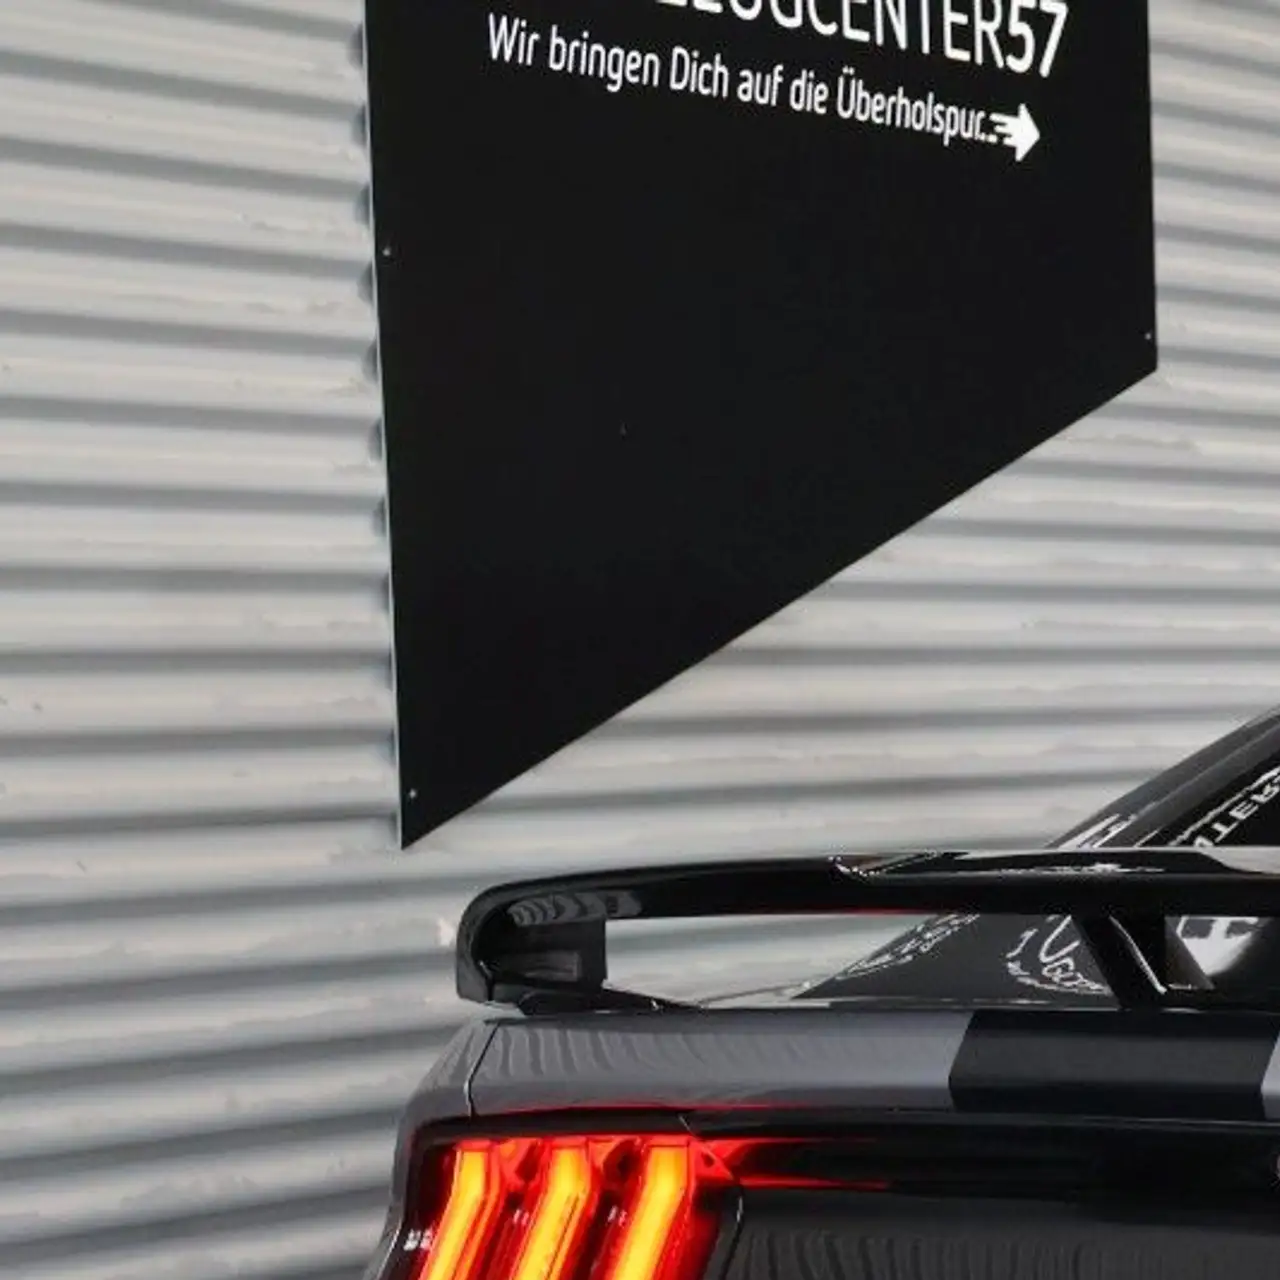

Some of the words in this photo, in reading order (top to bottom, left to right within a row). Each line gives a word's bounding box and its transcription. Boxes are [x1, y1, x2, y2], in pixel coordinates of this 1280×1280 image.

[488, 12, 540, 66] Wir
[549, 24, 660, 92] bringen
[669, 46, 729, 99] Dich
[736, 64, 784, 107] auf
[789, 69, 829, 114] die
